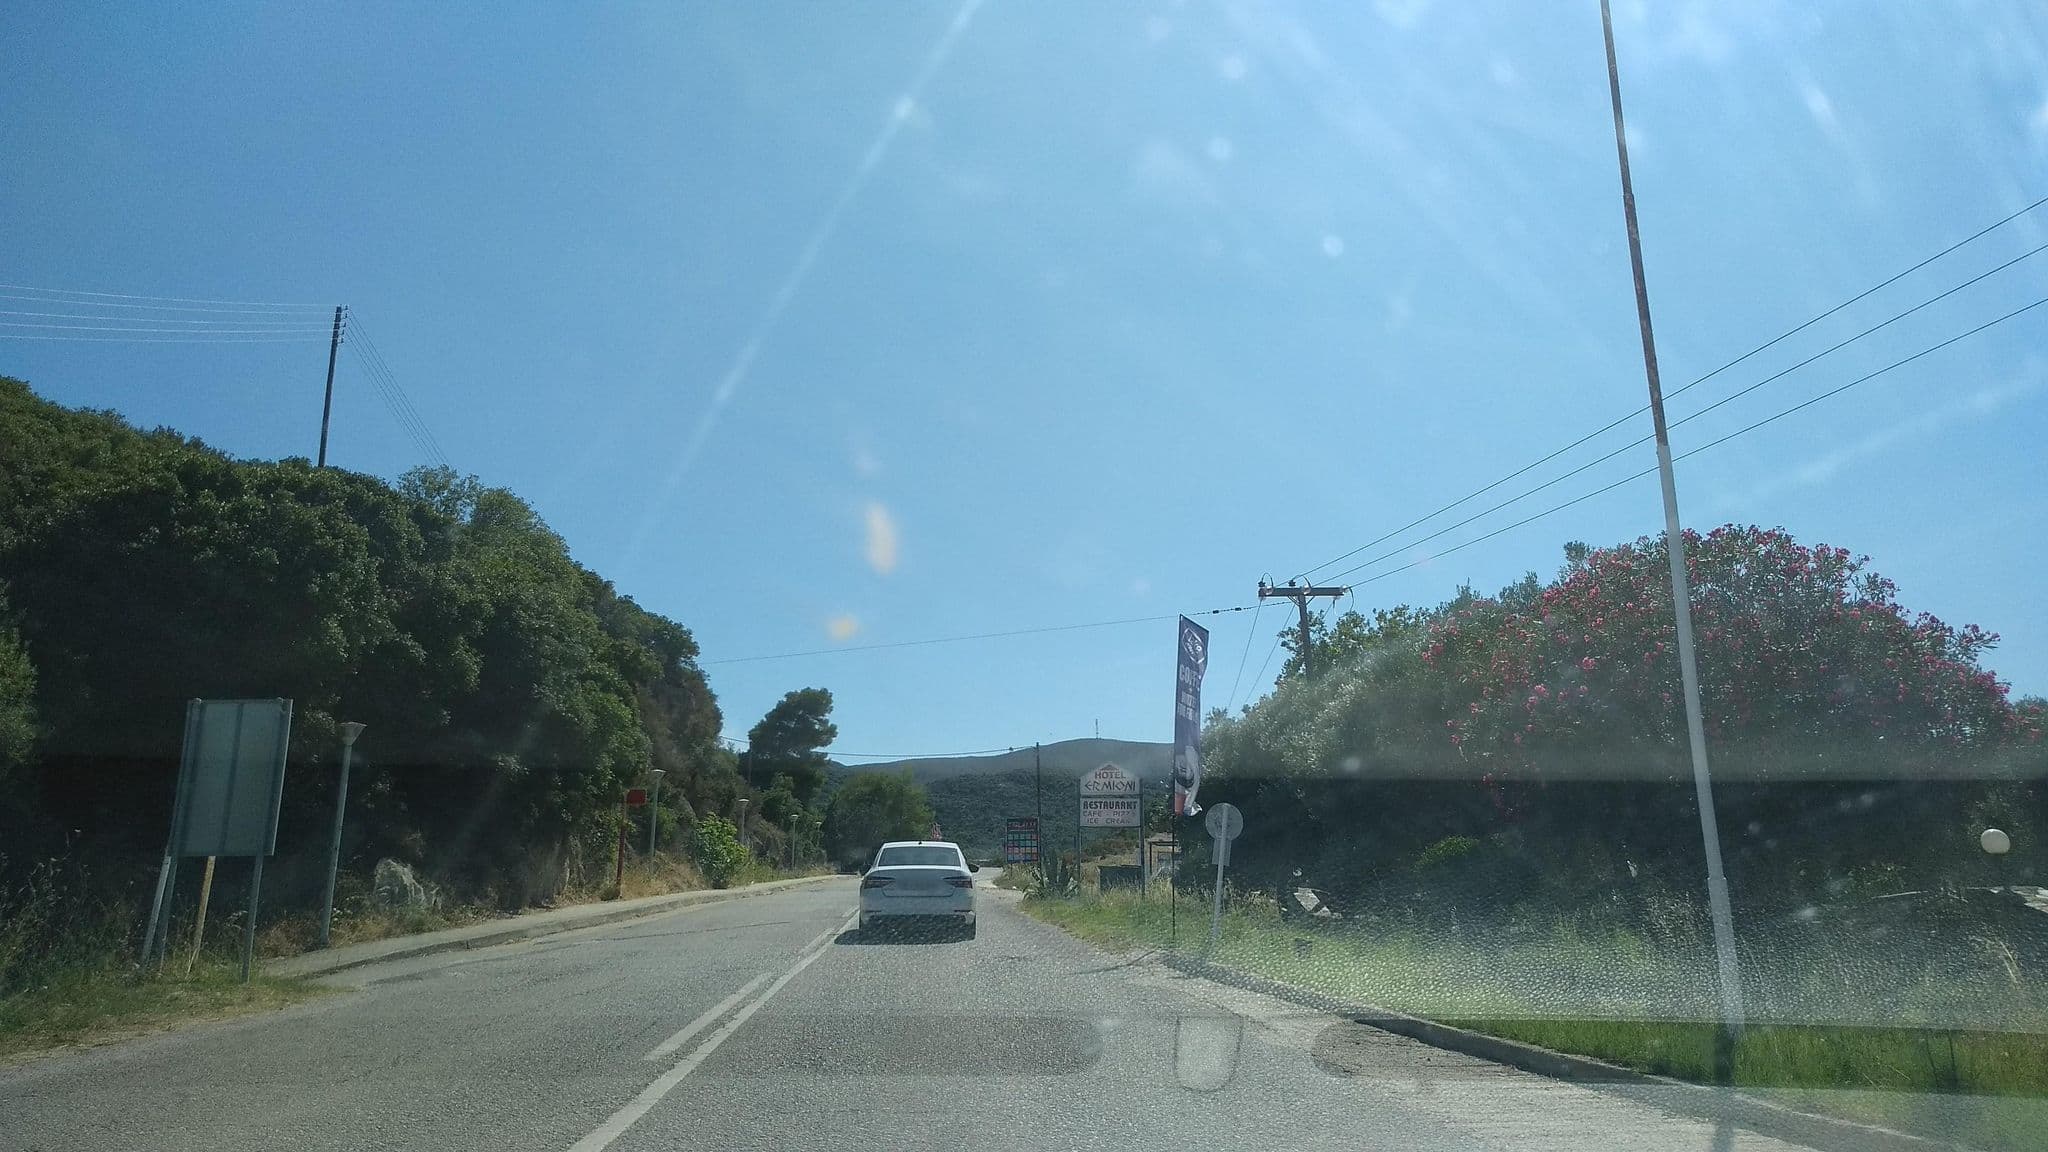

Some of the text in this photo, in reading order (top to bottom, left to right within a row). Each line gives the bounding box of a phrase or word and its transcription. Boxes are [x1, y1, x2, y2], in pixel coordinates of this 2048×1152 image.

[1094, 771, 1126, 779] HOTEL
[1084, 780, 1136, 792] ERMIONI
[1083, 800, 1138, 810] RESTAURANT
